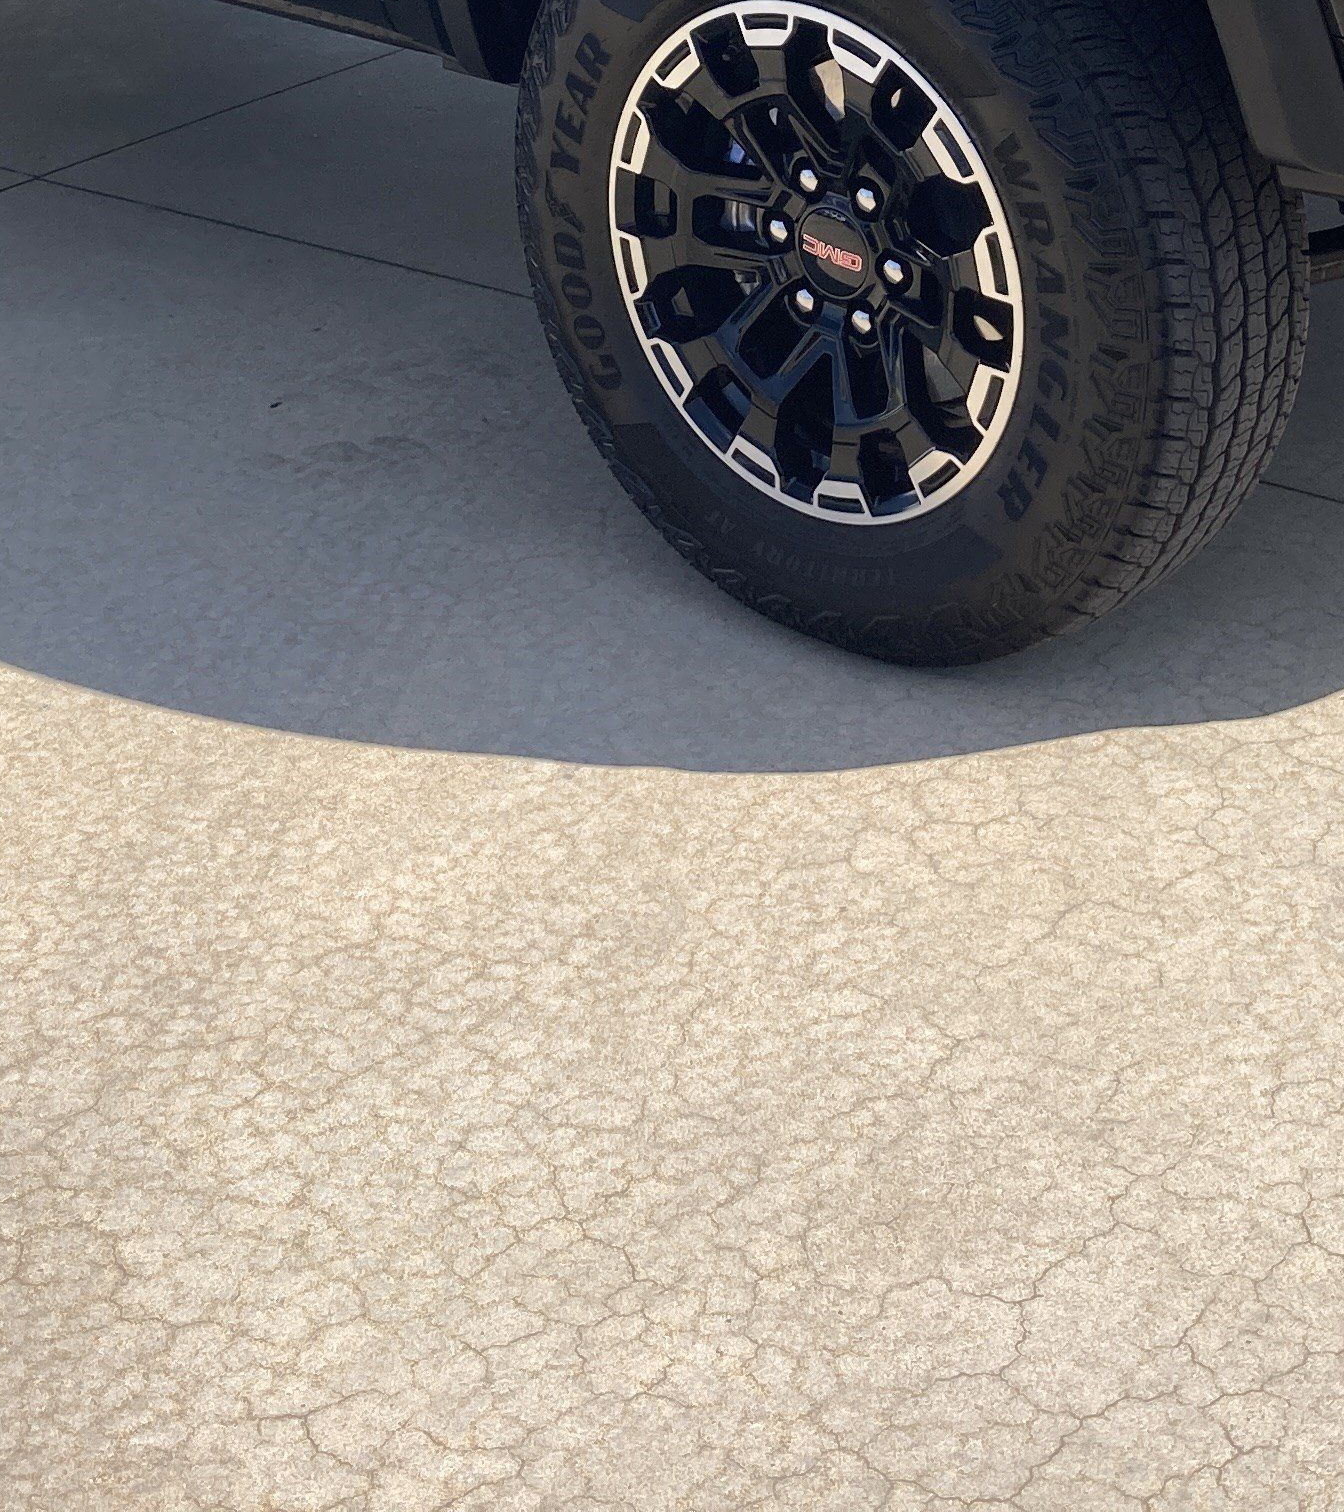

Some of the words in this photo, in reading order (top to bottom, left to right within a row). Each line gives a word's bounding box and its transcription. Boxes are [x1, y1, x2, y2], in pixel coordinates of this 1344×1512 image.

[544, 32, 622, 389] GOODYEAR
[803, 233, 863, 272] GMC
[993, 131, 1069, 522] WRANGLER
